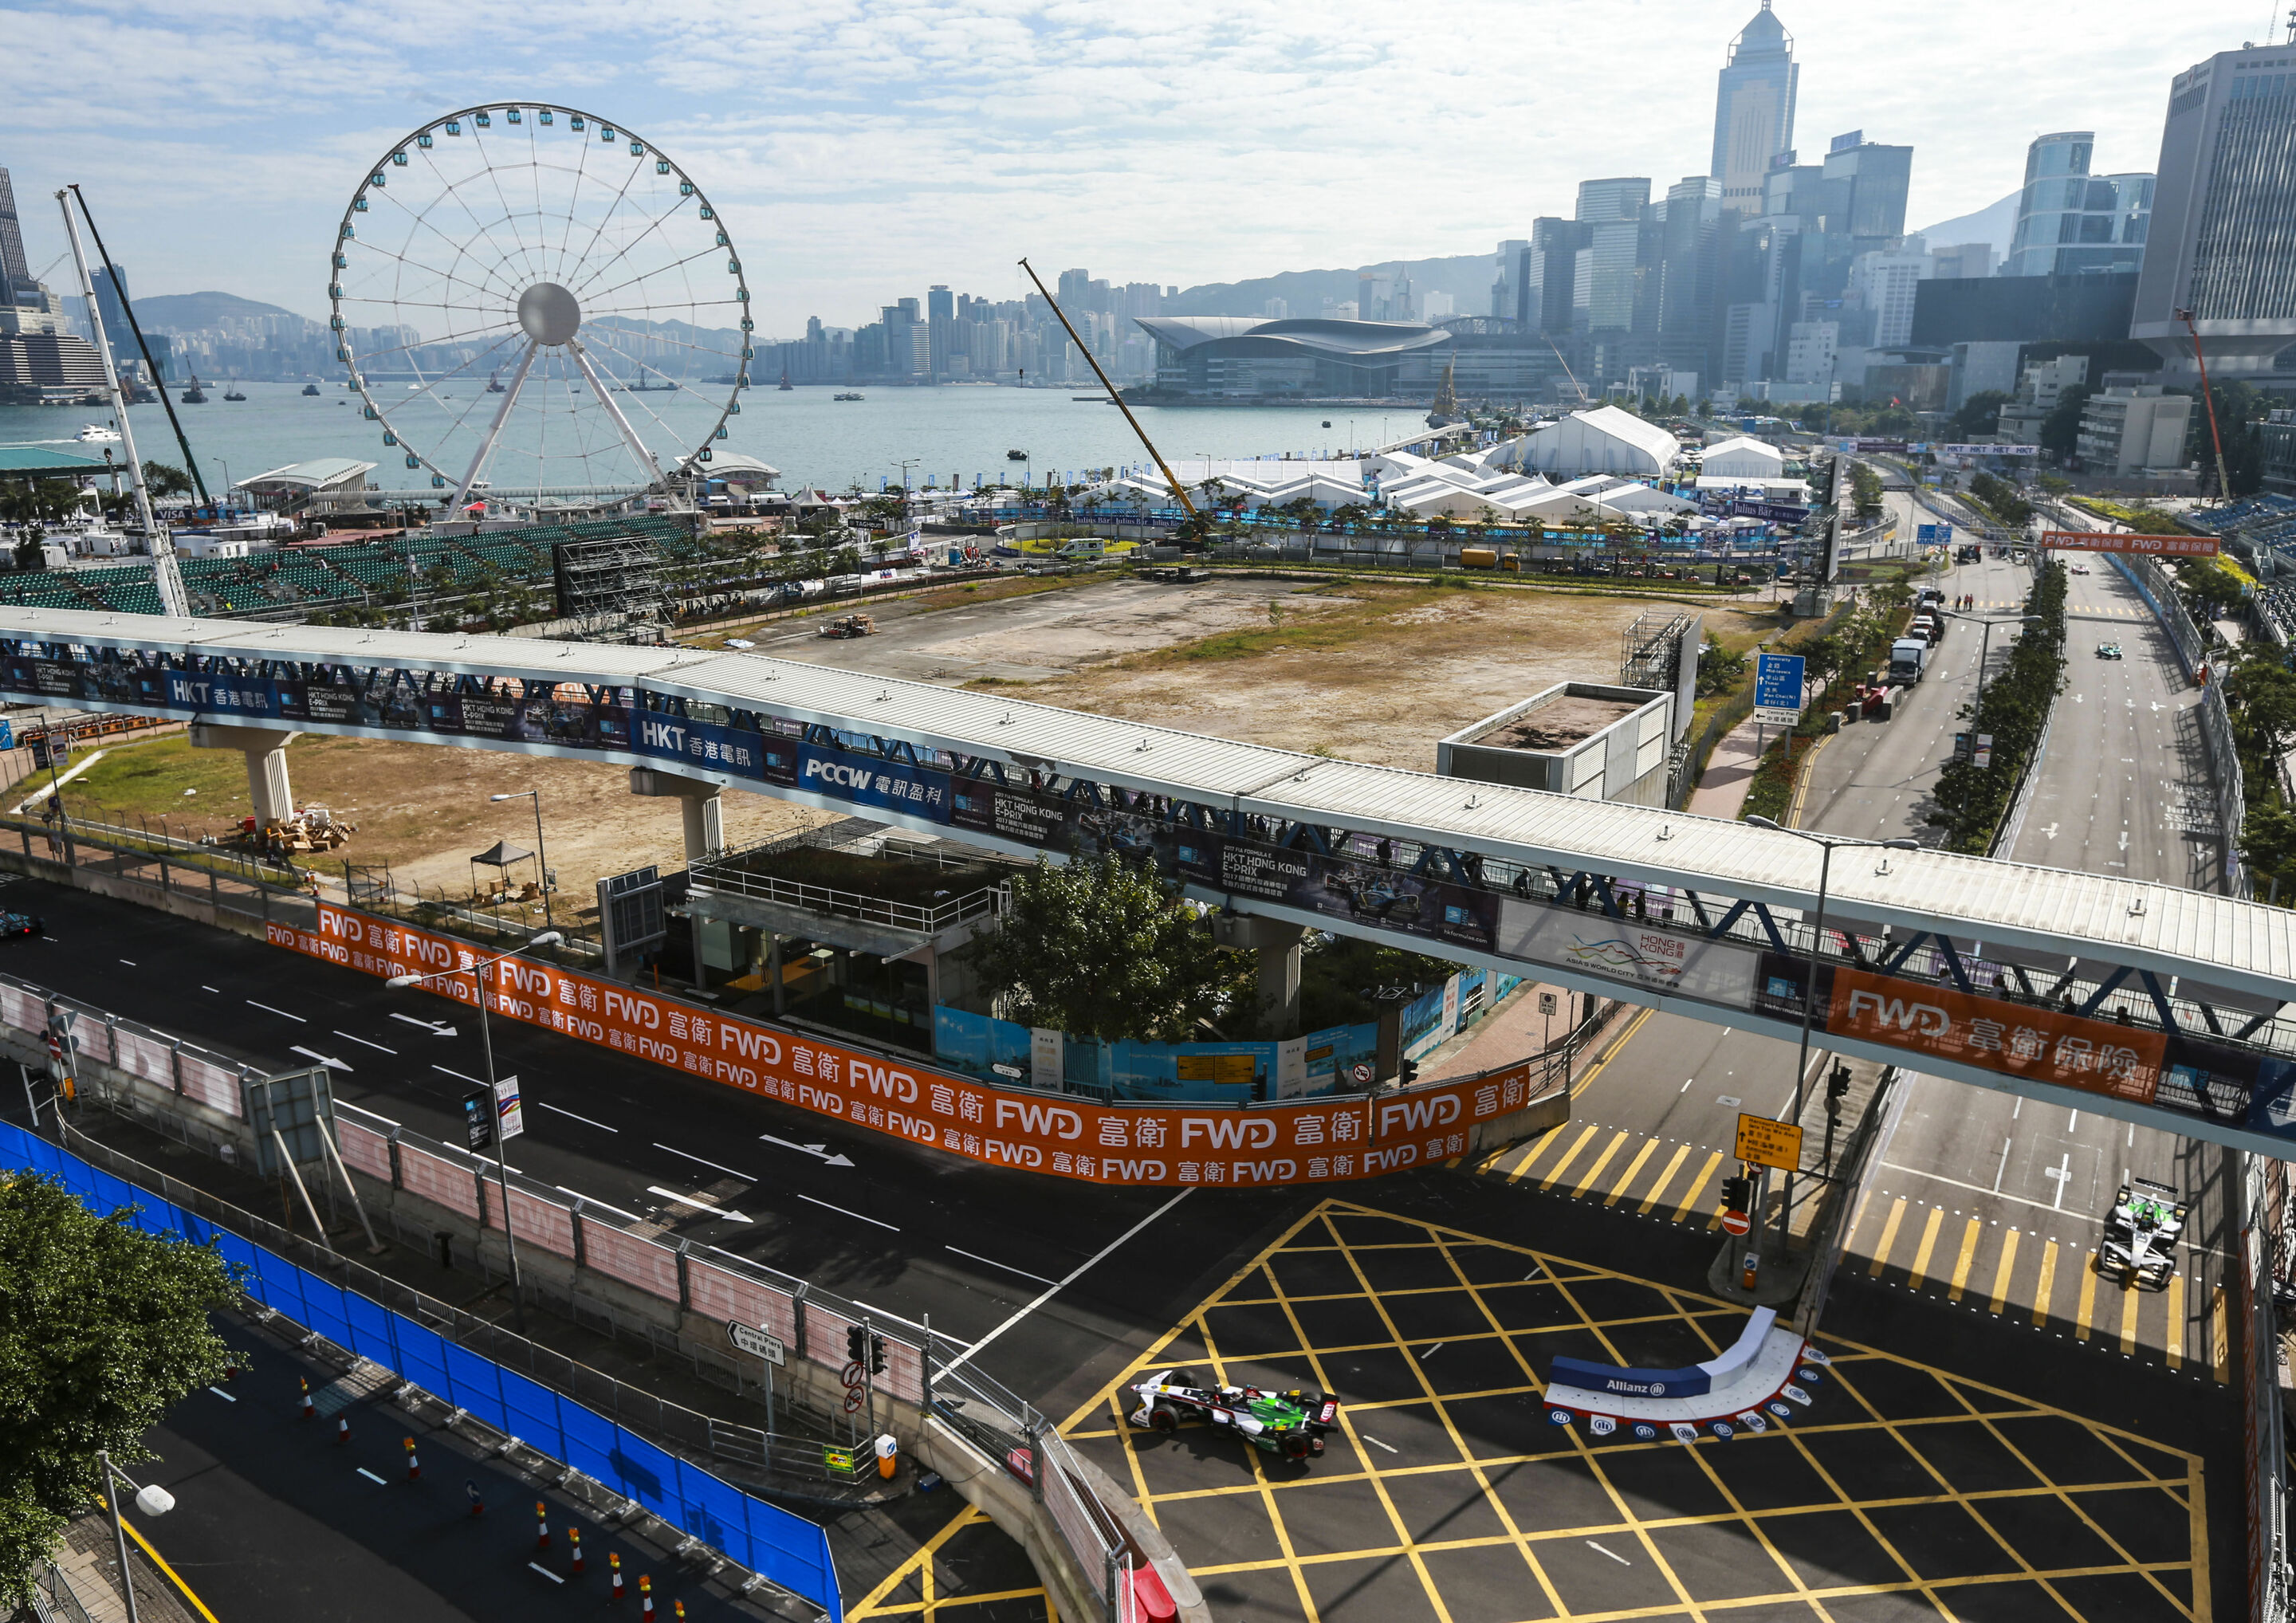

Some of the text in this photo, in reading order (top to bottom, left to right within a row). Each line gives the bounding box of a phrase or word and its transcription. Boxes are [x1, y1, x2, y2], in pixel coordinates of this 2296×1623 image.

[1735, 502, 1756, 515] Julius
[1759, 505, 1773, 517] Bär
[2045, 536, 2074, 545] FWD
[2131, 540, 2162, 550] FWD
[173, 680, 268, 709] HKT 香港電訊
[463, 711, 485, 720] E-PRIX
[643, 721, 751, 767] HKT 香港電訊
[805, 758, 942, 805] PCCW 電訊盈科
[995, 797, 1063, 821] HKT HONG KONG
[1012, 795, 1029, 804] FORMULA
[995, 807, 1022, 821] E-PRIX
[1244, 848, 1267, 857] FORMULA
[1223, 862, 1257, 876] E-PRIX
[1224, 851, 1307, 877] HKT HONG KONG
[1444, 929, 1488, 944] hkformulae.com
[1641, 934, 1675, 948] HONG
[1640, 942, 1674, 956] KONG
[1566, 957, 1590, 967] ASIA'S
[1590, 963, 1617, 973] WORLD
[1617, 969, 1635, 978] CITY
[320, 909, 1362, 1150] FWD 富衛 FWD 富衛 FWD 富衛 FWD 富衛 FWD 富衛 FWD 富衛 FWD 富衛 FWD 富衛
[1848, 989, 2139, 1080] FWD 富衛保險
[267, 925, 294, 947] FWD
[298, 933, 319, 954] 富衛
[320, 941, 348, 964] FWD
[352, 951, 375, 973] 富衛
[376, 958, 407, 981] FWD
[436, 975, 468, 1000] FWD
[499, 993, 533, 1020] FWD
[538, 1007, 564, 1030] 富衛
[567, 1015, 603, 1041] FWD
[609, 1028, 636, 1052] 富衛
[639, 1036, 678, 1064] FWD
[683, 1051, 712, 1076] 富衛
[716, 1060, 757, 1089] FWD
[764, 1075, 796, 1102] 富衛
[799, 1084, 843, 1114] FWD
[850, 1101, 883, 1128] 富衛
[887, 1110, 936, 1142] FWD
[944, 1127, 981, 1156] 富衛
[985, 1138, 1043, 1168] FWD
[1052, 1151, 1095, 1177] 富衛
[1103, 1158, 1166, 1181] FWD
[1177, 1160, 1225, 1183] 富衛
[1233, 1158, 1297, 1183] FWD
[1307, 1154, 1354, 1177] 富衛
[2195, 1069, 2209, 1091] HKG
[1380, 1073, 1526, 1138] FWD 富衛
[1363, 1132, 1464, 1173] FWD 富衛
[739, 1326, 781, 1349] Central Piers
[740, 1338, 776, 1360] 中環碼頭
[1606, 1379, 1649, 1393] Allianz
